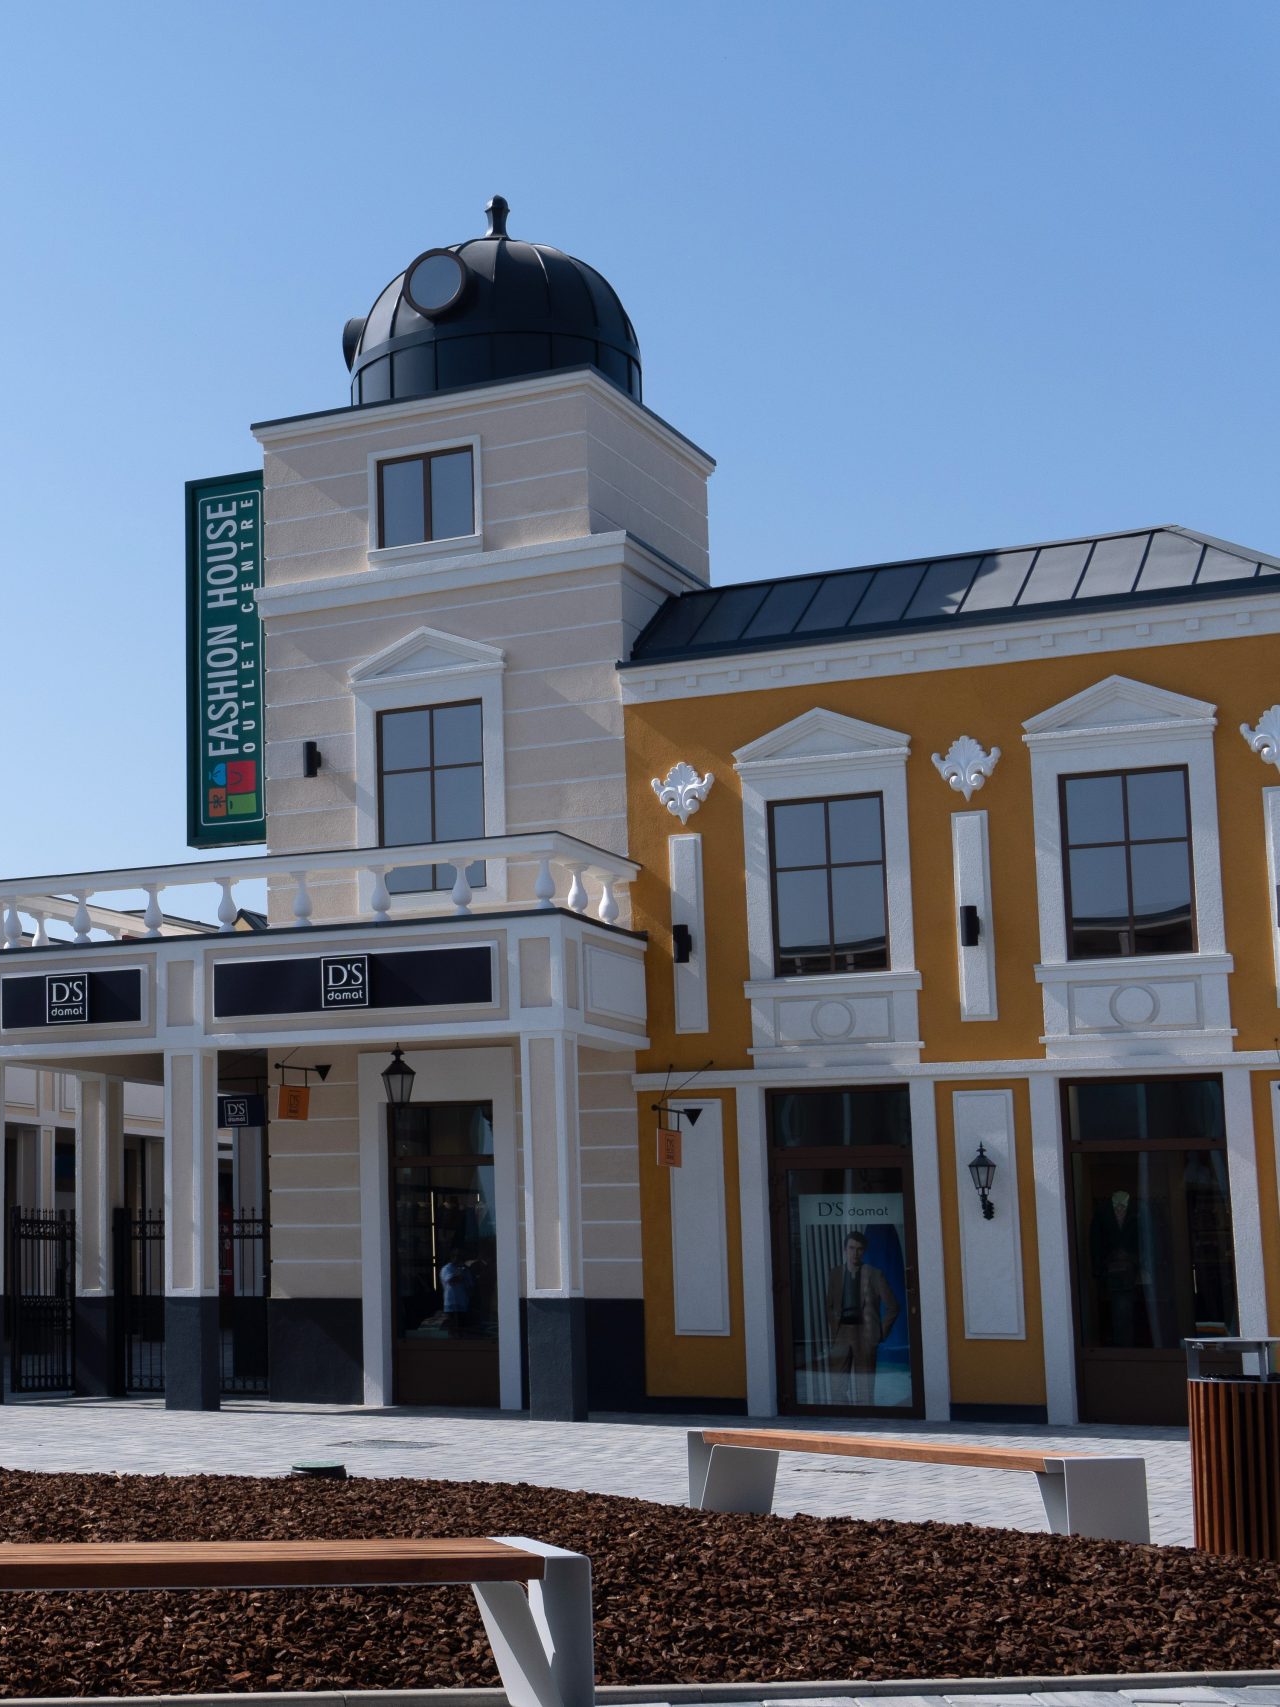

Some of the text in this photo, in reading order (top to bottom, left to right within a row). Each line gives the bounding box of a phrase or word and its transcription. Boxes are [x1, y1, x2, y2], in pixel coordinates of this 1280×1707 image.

[206, 501, 239, 757] FASHION HOUSE
[241, 498, 256, 753] OUTLET CENTRE
[327, 963, 363, 986] D'S
[51, 981, 83, 1003] D'S
[327, 989, 363, 1001] damat
[51, 1006, 83, 1016] damat
[227, 1103, 246, 1115] D'S
[818, 1201, 889, 1217] D'S damat
